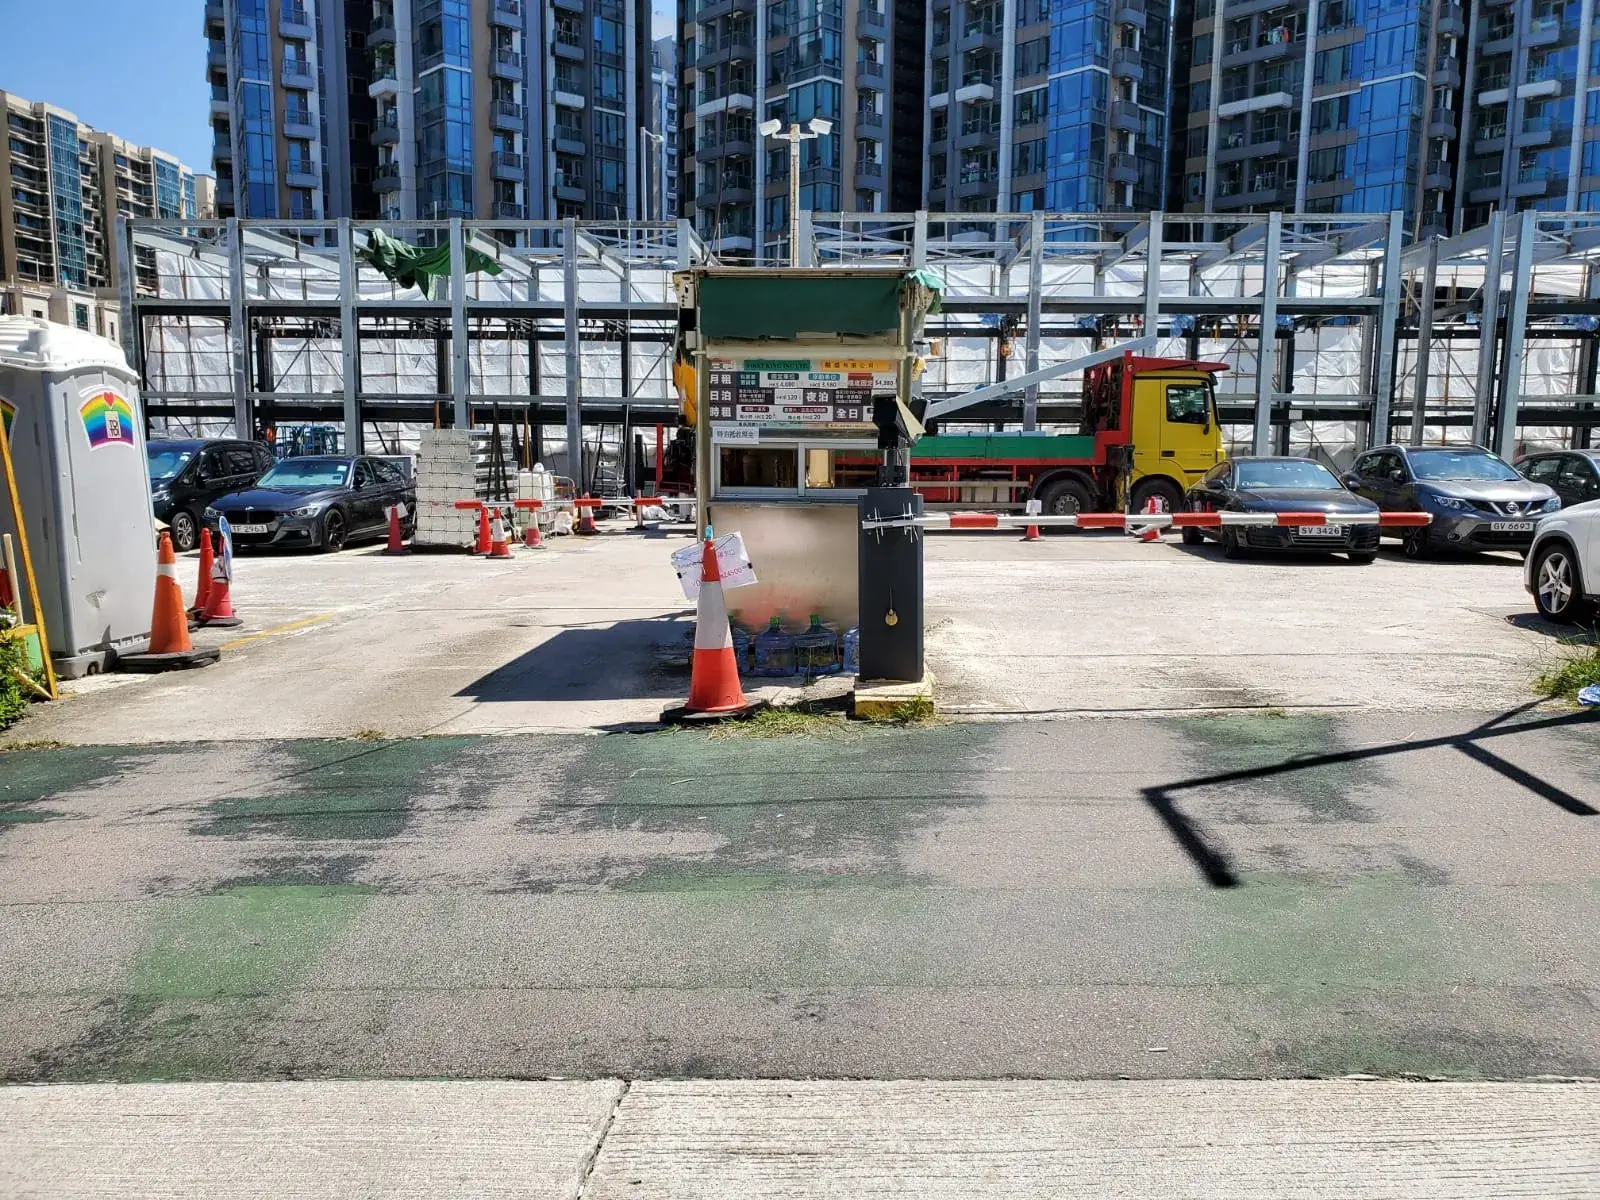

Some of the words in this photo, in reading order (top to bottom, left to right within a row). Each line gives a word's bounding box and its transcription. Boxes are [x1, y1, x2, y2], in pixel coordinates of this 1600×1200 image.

[710, 374, 731, 385] 月租
[710, 390, 732, 402] 日泊
[806, 391, 829, 403] 夜泊
[709, 406, 732, 417] 時租
[836, 408, 858, 419] 全日
[1316, 527, 1340, 535] 3426
[1493, 522, 1506, 530] GV
[1507, 522, 1531, 530] 6693
